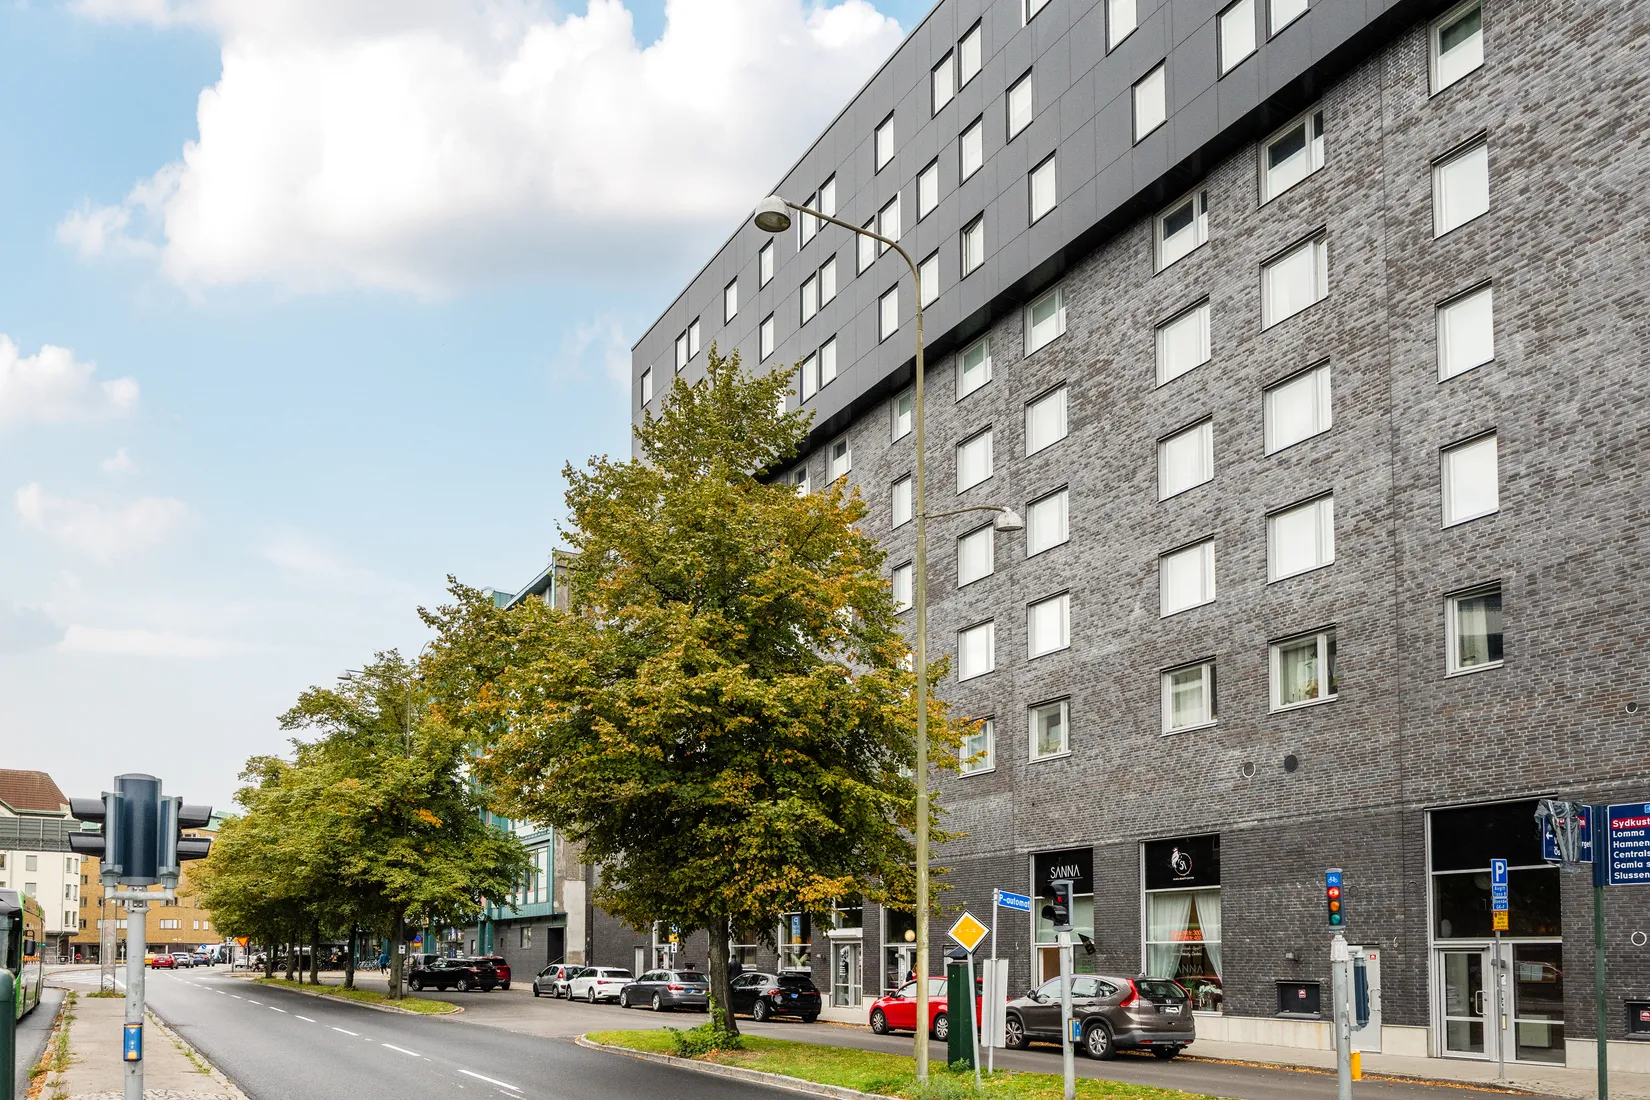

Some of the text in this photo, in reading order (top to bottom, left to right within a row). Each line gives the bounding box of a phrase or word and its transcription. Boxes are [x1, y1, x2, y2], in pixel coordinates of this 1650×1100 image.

[1612, 830, 1645, 838] Lomma
[1613, 840, 1650, 848] Hamnen
[1614, 861, 1643, 869] Gamla
[1050, 864, 1080, 879] SANNA
[1495, 861, 1505, 882] P
[1614, 872, 1650, 880] Slussen
[998, 894, 1030, 908] P-automat
[1177, 963, 1204, 974] ANNA
